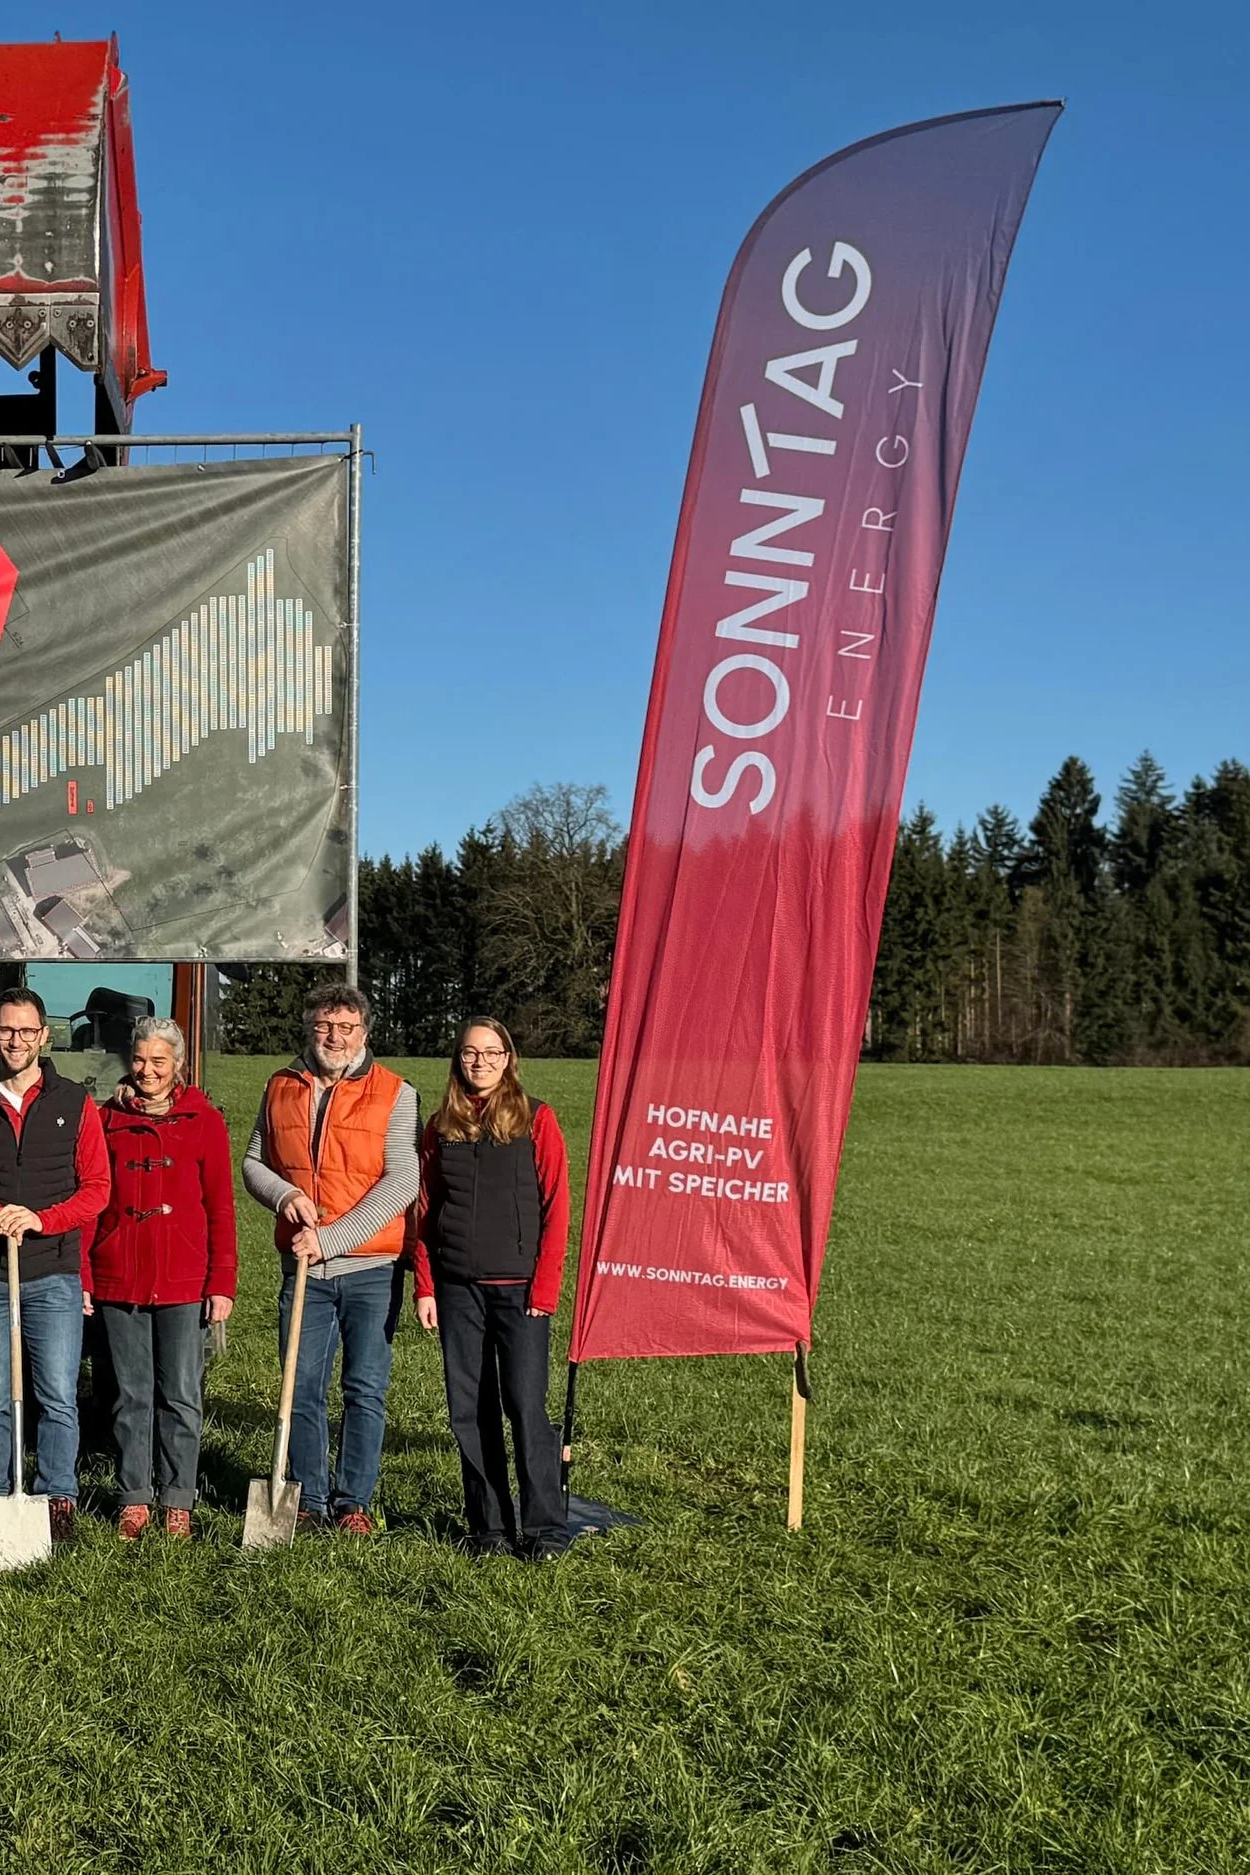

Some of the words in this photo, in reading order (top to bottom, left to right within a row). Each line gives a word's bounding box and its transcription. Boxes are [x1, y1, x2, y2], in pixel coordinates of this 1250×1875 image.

[690, 240, 872, 815] SONNTAG
[826, 368, 924, 721] ENERGY
[646, 1103, 774, 1140] HOFNAHE
[648, 1136, 764, 1170] AGRI-PV
[612, 1165, 662, 1190] MIT
[668, 1171, 790, 1203] SPEICHER
[596, 1260, 789, 1291] WWW.SONNTAG.ENERGY
